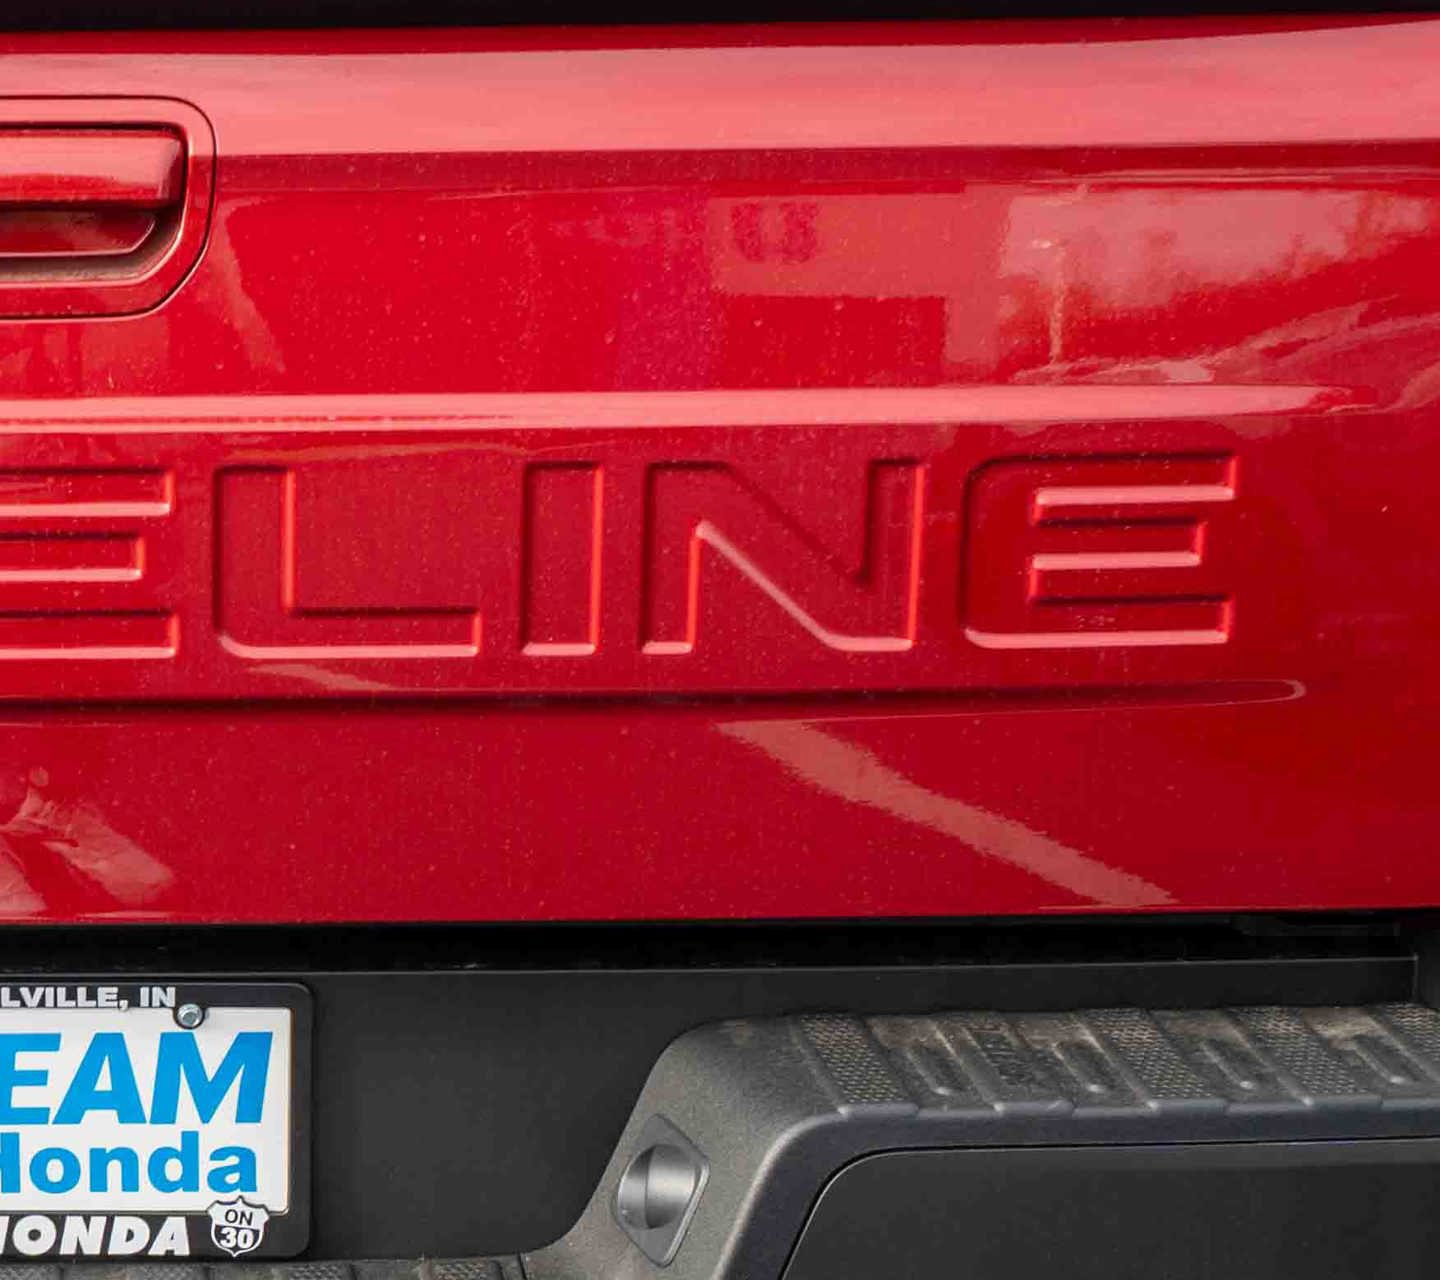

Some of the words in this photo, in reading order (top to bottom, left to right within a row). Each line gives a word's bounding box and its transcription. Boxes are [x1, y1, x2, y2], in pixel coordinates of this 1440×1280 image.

[140, 986, 176, 1008] IN
[224, 1208, 253, 1226] ON
[220, 1226, 254, 1249] 30
